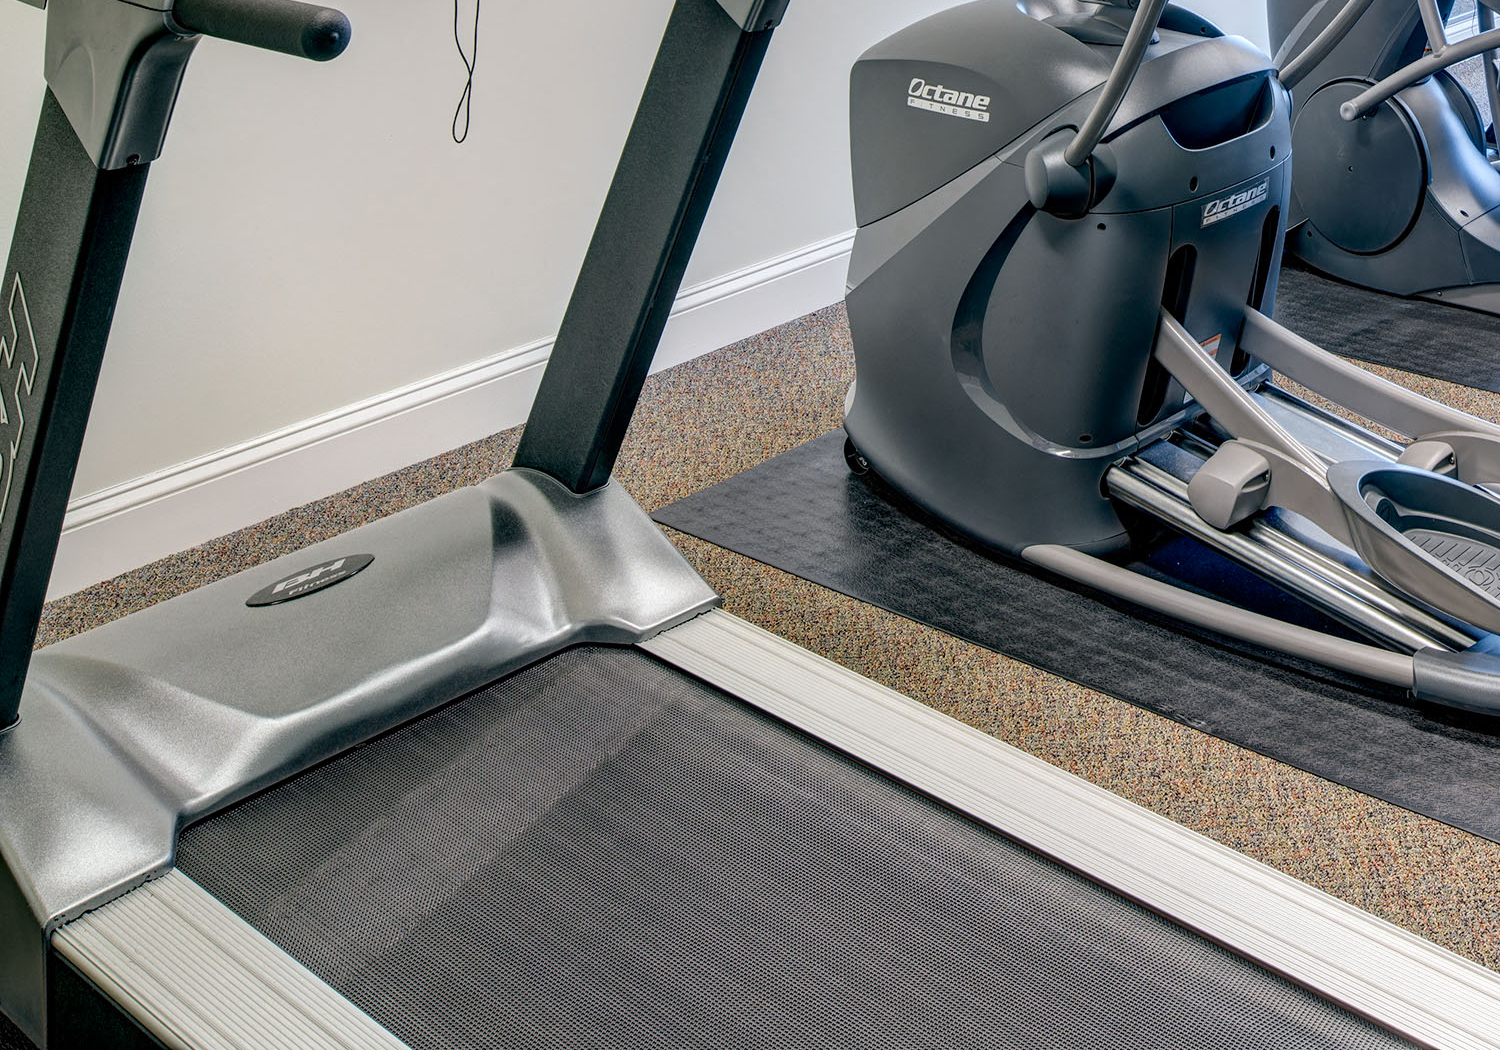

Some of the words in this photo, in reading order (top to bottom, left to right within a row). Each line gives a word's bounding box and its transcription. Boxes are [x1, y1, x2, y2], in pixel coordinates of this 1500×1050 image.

[908, 77, 991, 110] Octane
[909, 98, 985, 120] FITNESS
[1203, 182, 1267, 217] Octane
[272, 558, 346, 594] BH
